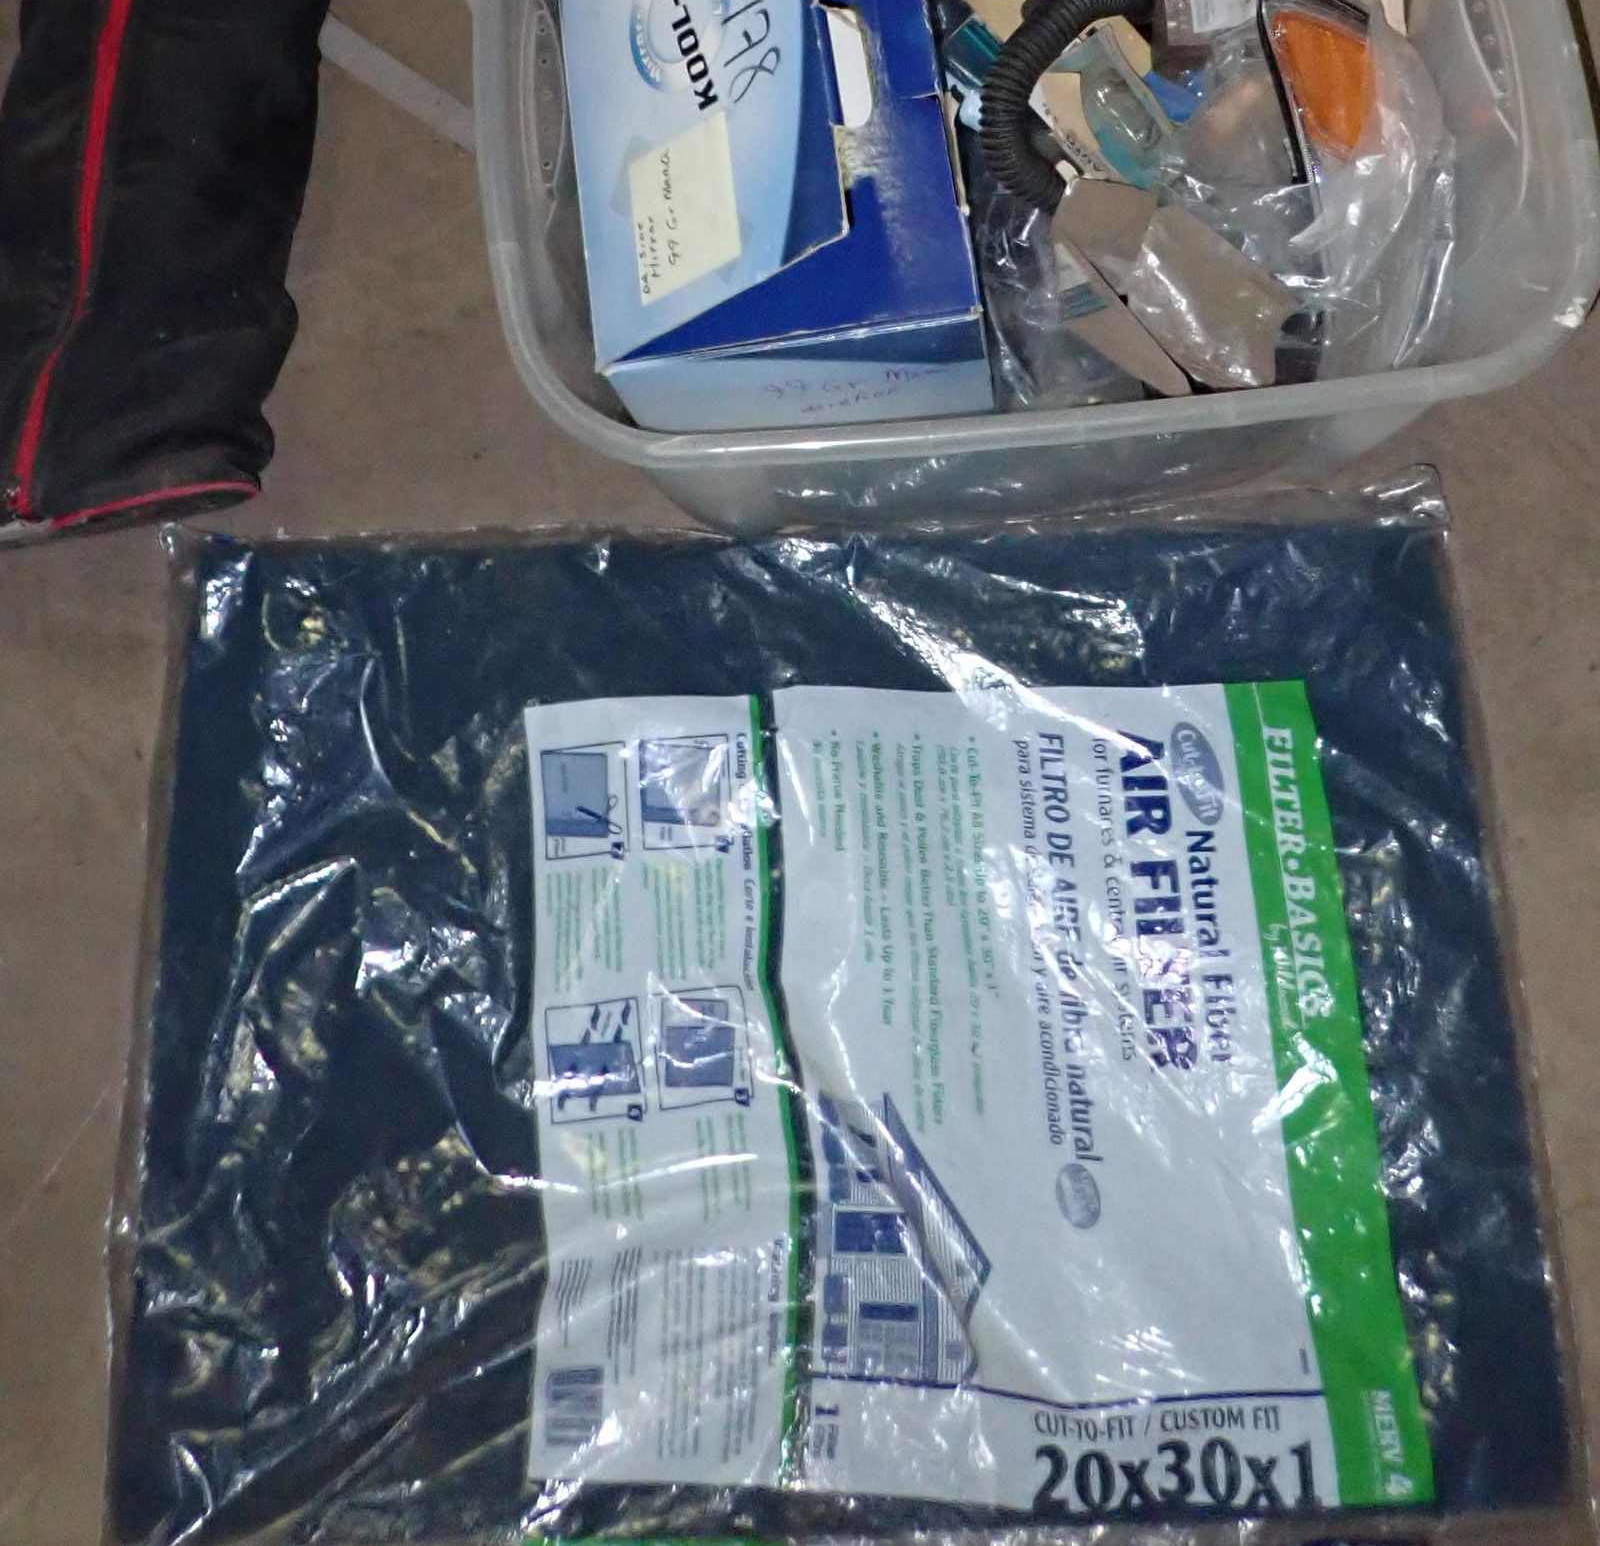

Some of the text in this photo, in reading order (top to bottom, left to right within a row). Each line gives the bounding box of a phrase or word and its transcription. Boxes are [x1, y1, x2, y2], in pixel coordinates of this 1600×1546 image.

[1013, 740, 1029, 775] para
[1039, 732, 1070, 824] FILTRO
[1118, 729, 1173, 836] AIR
[1018, 778, 1036, 838] sistema
[1096, 767, 1115, 847] furnaces
[1047, 832, 1075, 867] DE
[1103, 853, 1123, 870] &
[1185, 830, 1230, 958] Natural
[1036, 982, 1049, 1015] aire
[1065, 1063, 1103, 1162] natural
[1034, 1410, 1135, 1440] CUT-TO-FIT
[1160, 1408, 1245, 1431] CUSTOM
[1252, 1404, 1281, 1430] FIT
[1032, 1436, 1321, 1514] 20x30x1
